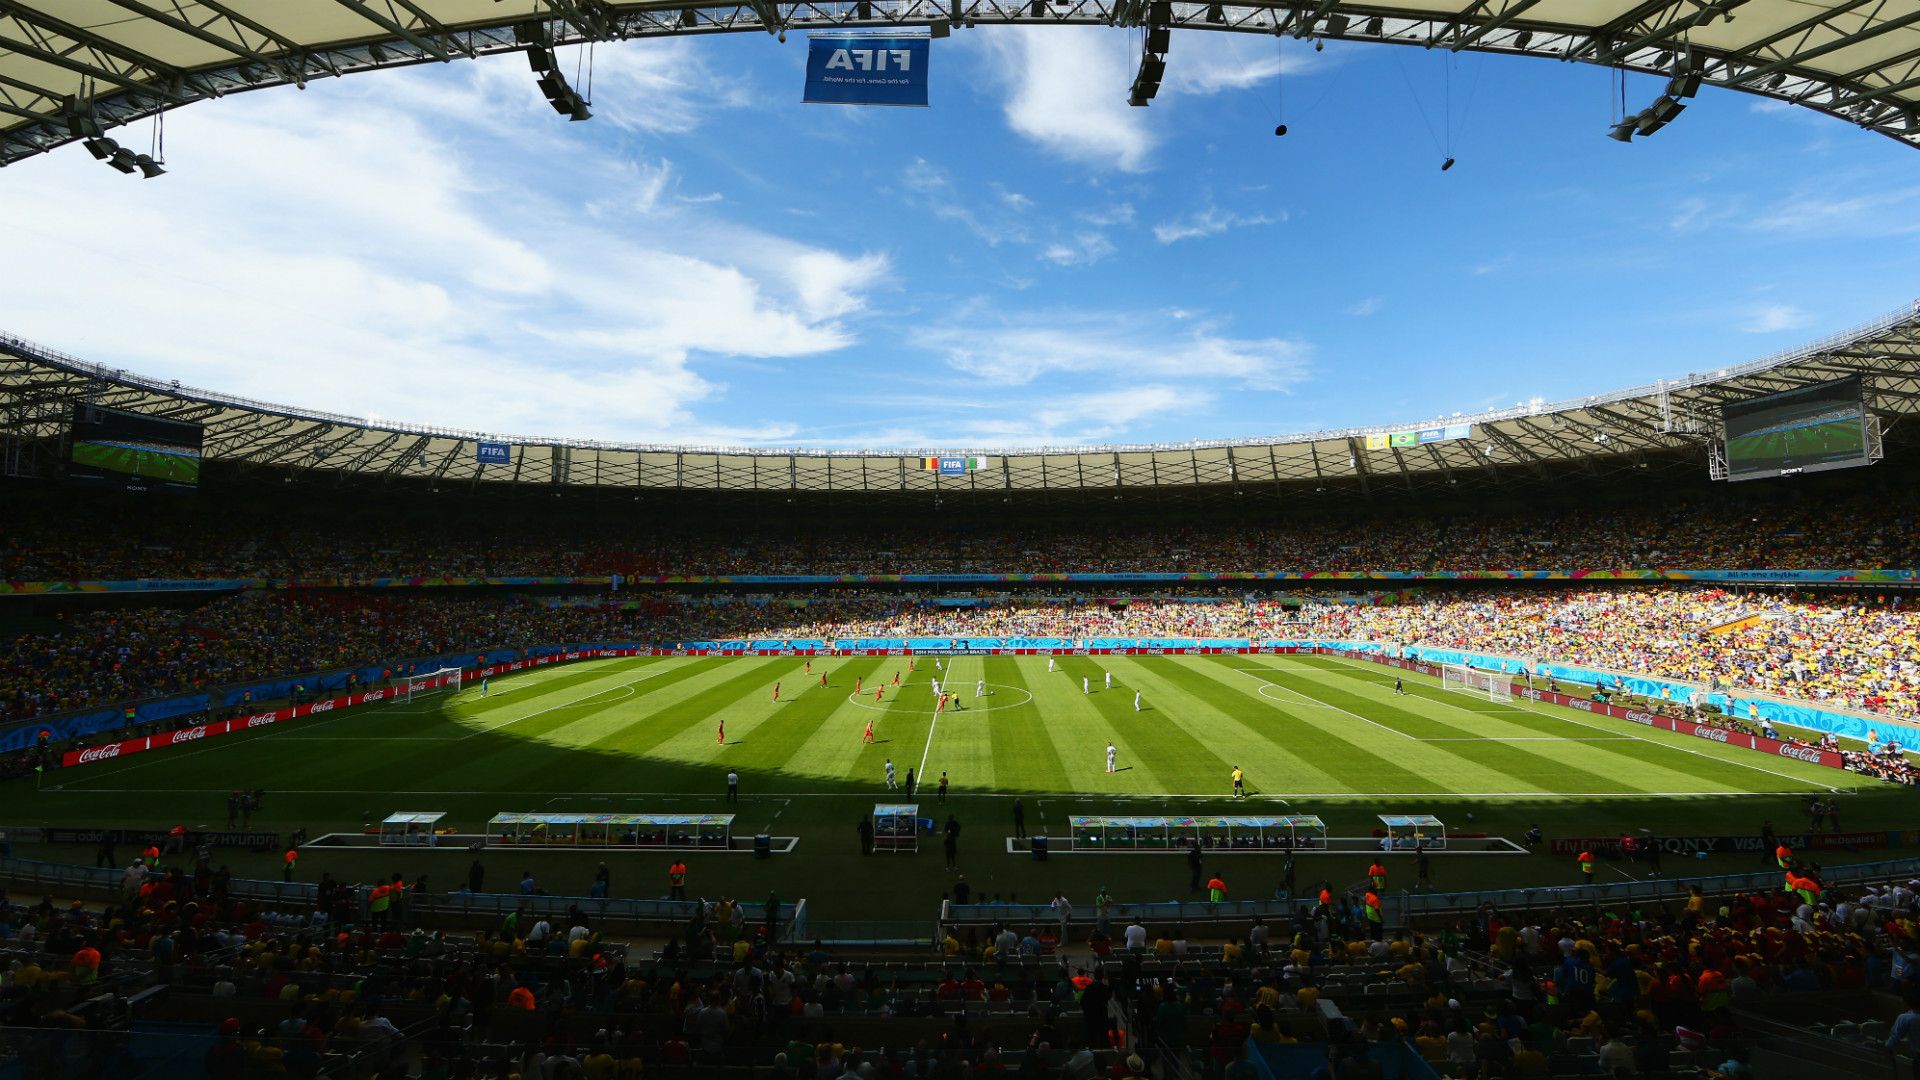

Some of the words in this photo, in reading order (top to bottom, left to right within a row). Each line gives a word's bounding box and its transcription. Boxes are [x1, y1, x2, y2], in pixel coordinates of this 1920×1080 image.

[481, 447, 505, 456] FIFA
[943, 461, 962, 469] FIFA
[1781, 467, 1803, 475] SONY
[1734, 838, 1765, 850] VISA
[1573, 966, 1588, 985] 10
